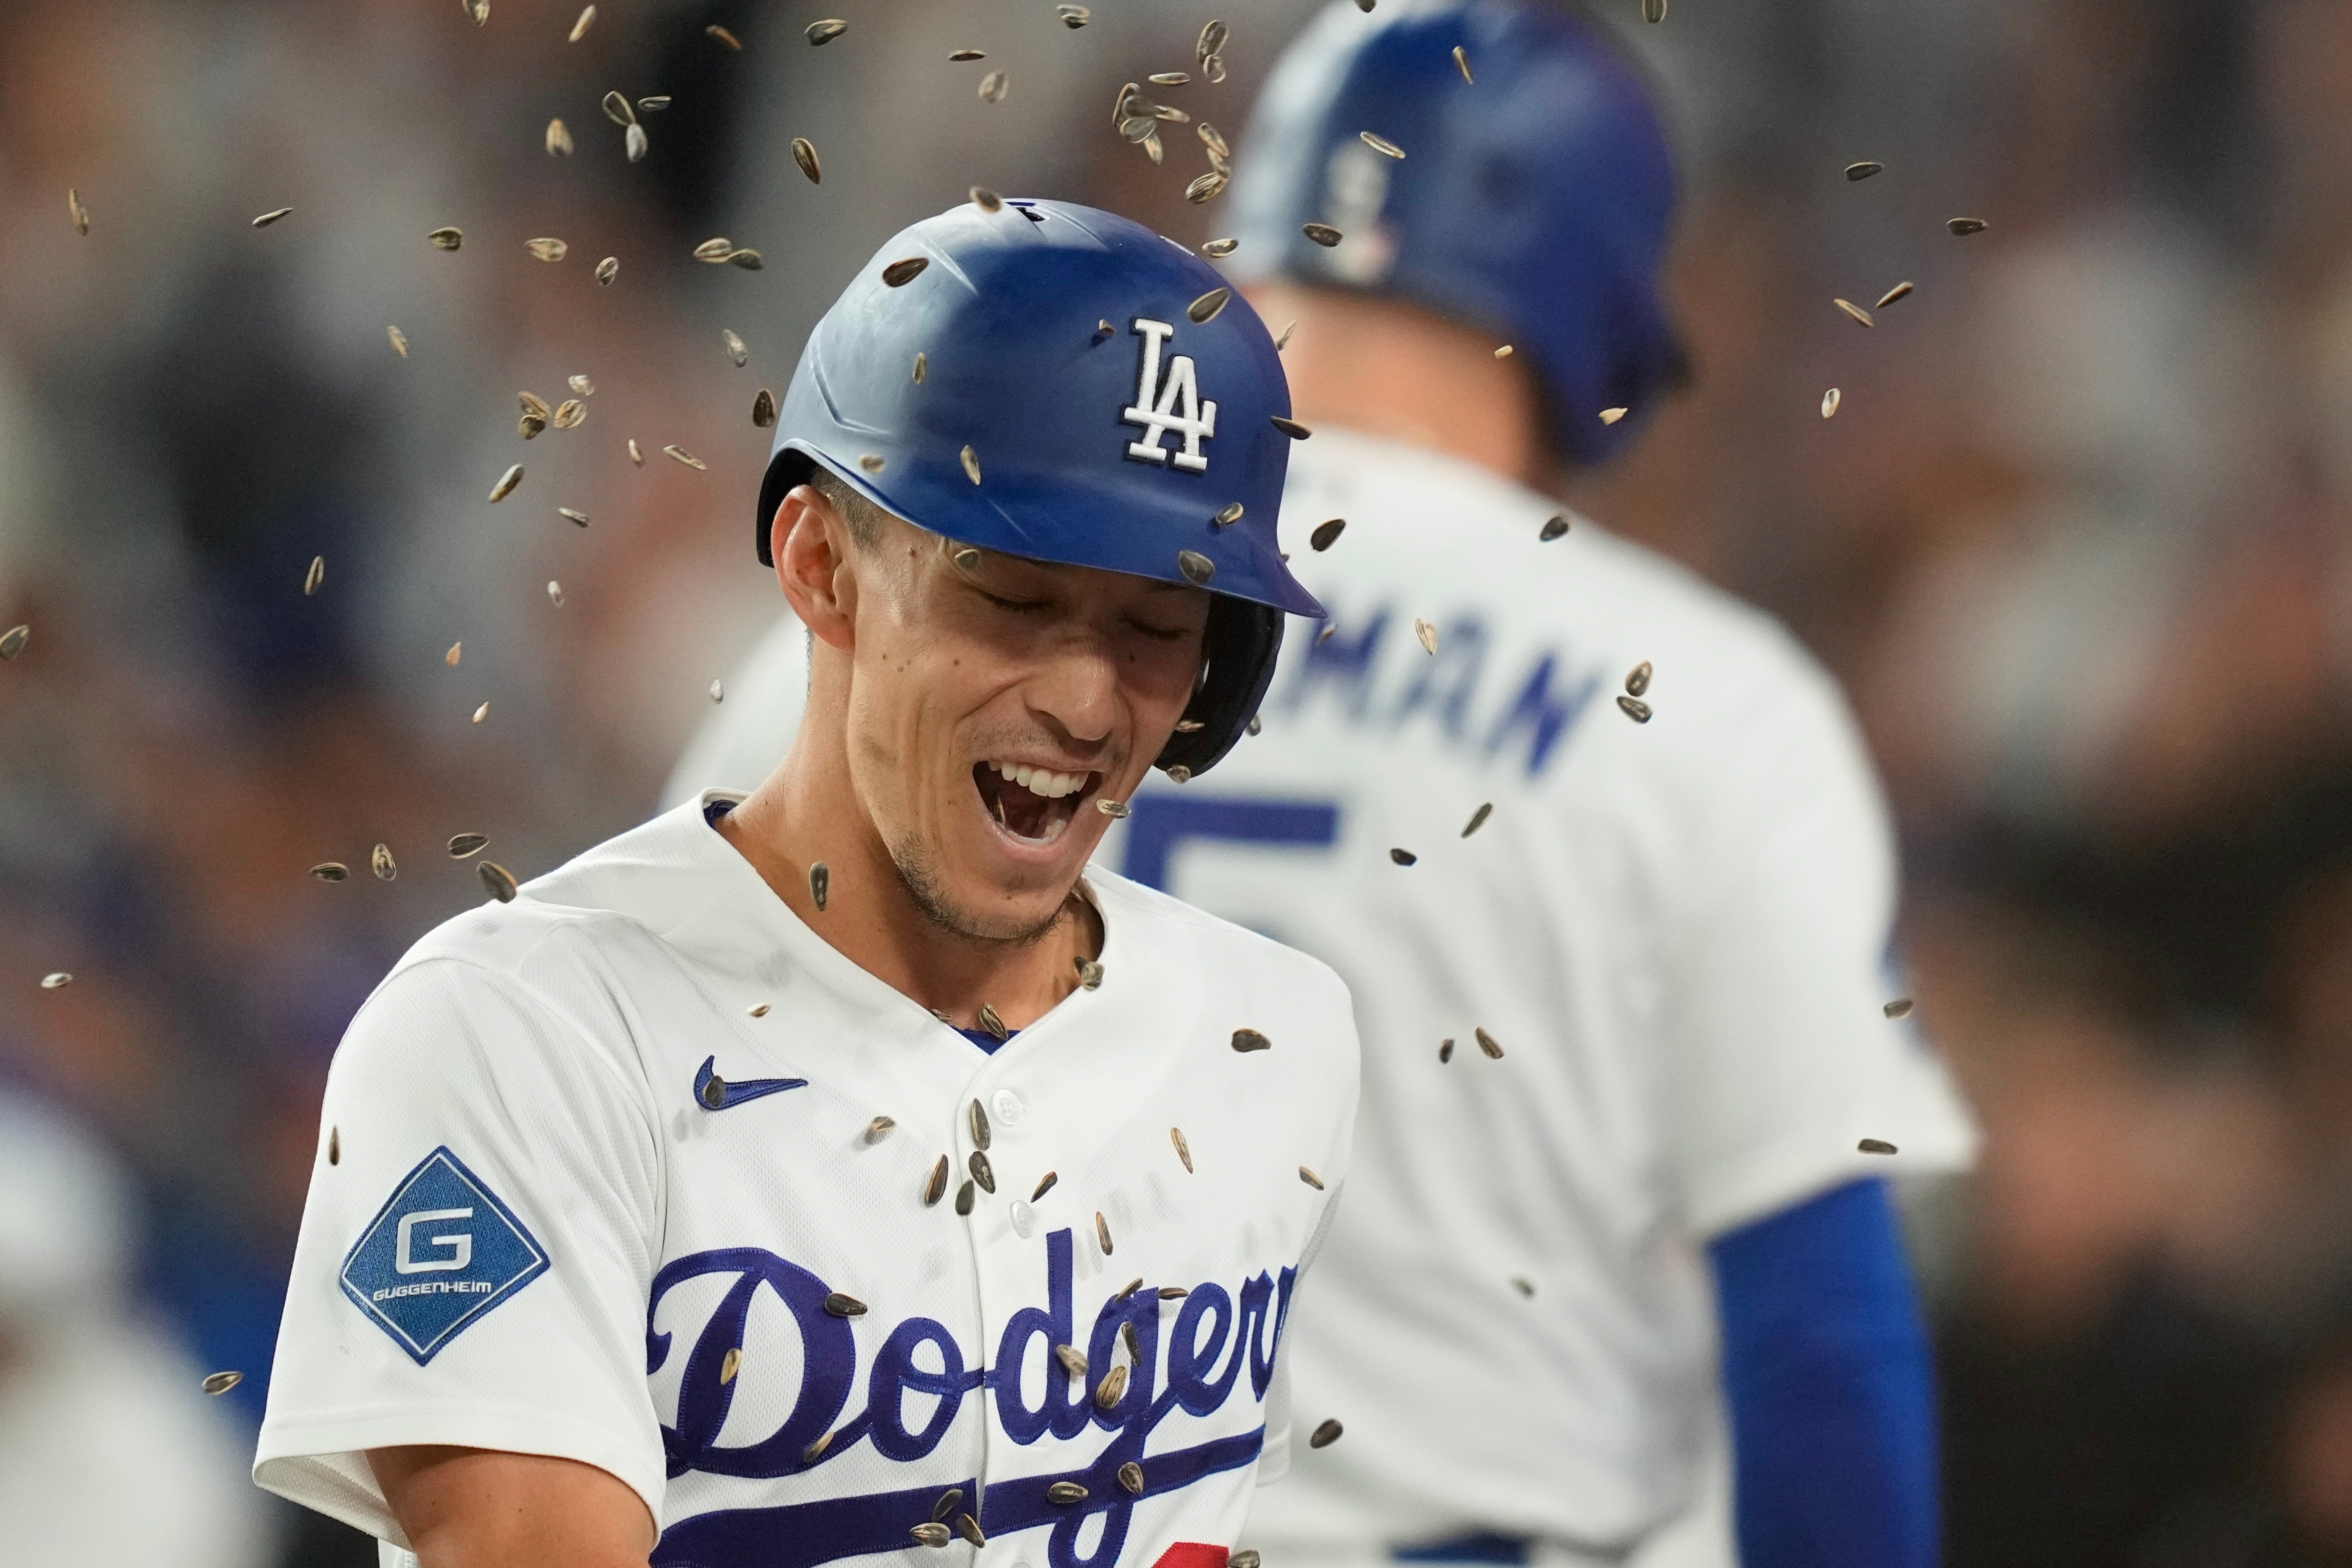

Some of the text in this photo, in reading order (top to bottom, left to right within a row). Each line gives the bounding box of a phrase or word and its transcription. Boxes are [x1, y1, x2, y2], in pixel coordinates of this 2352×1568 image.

[1122, 317, 1217, 472] LA
[373, 1281, 491, 1301] GUGGENHEIM
[396, 1207, 473, 1274] G
[646, 1227, 1298, 1567] Dodger
